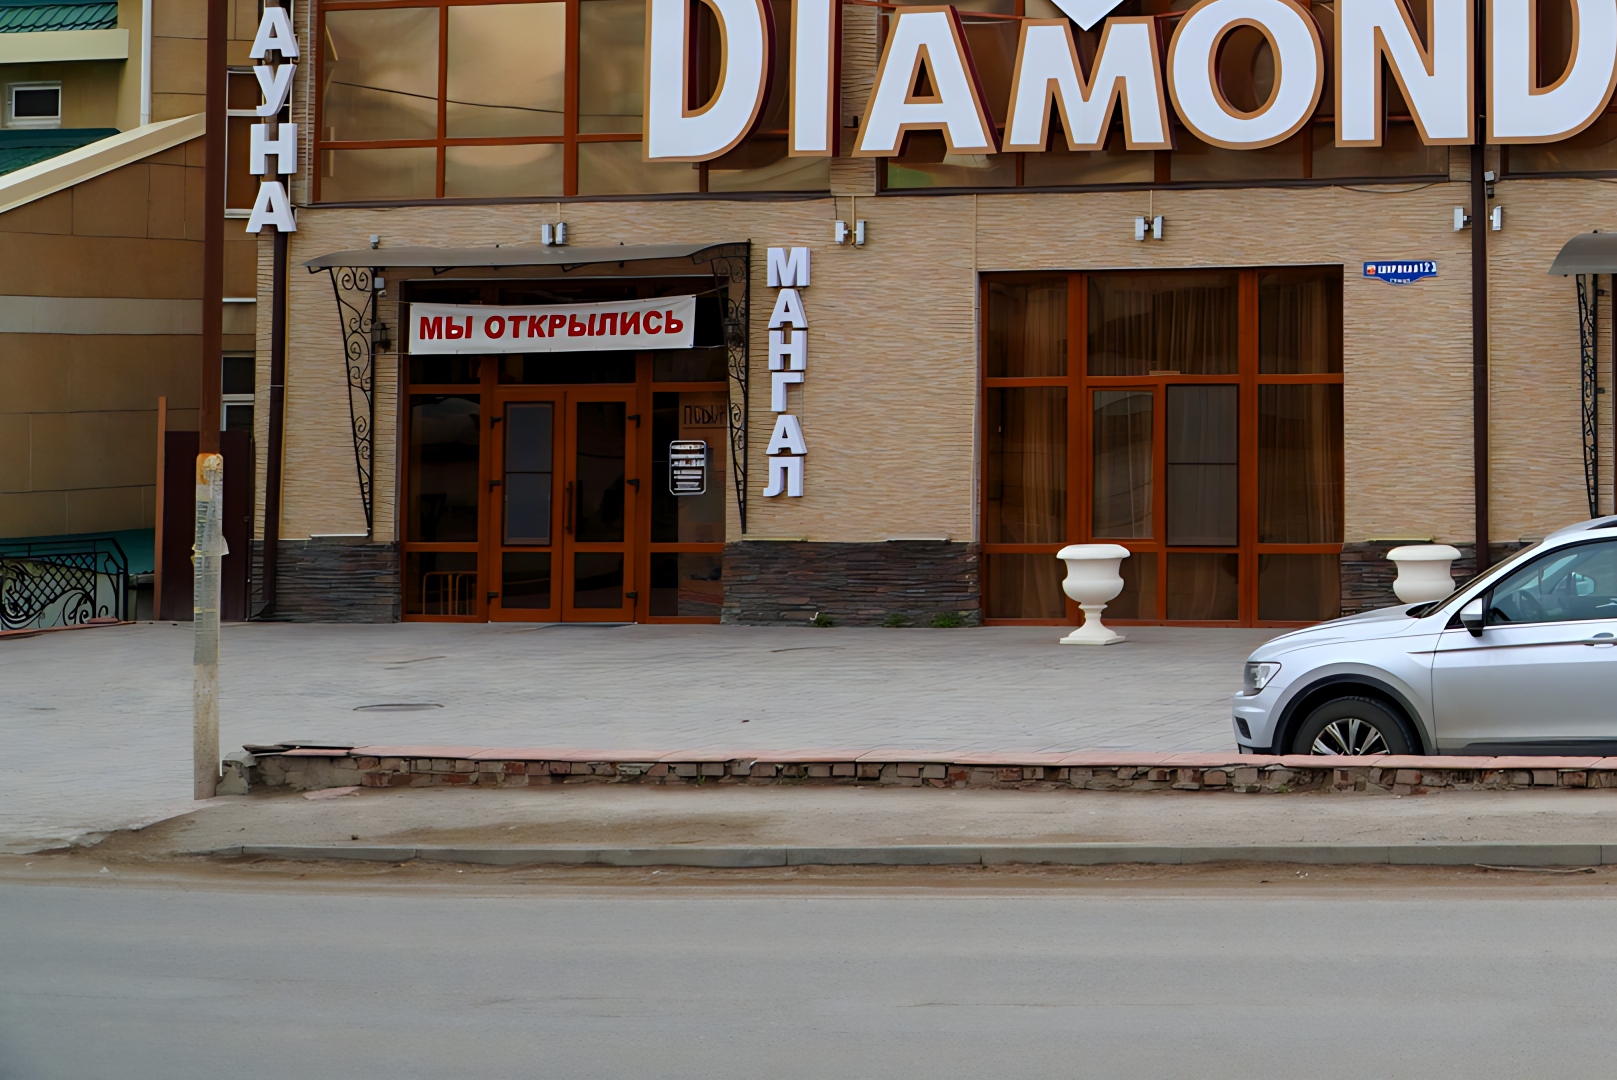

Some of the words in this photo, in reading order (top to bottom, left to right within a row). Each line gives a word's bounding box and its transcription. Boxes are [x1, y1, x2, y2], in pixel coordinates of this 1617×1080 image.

[419, 315, 474, 340] МЫ
[484, 310, 684, 340] ОТКРЫЛИСЬ
[763, 247, 811, 497] МАНГАЛ
